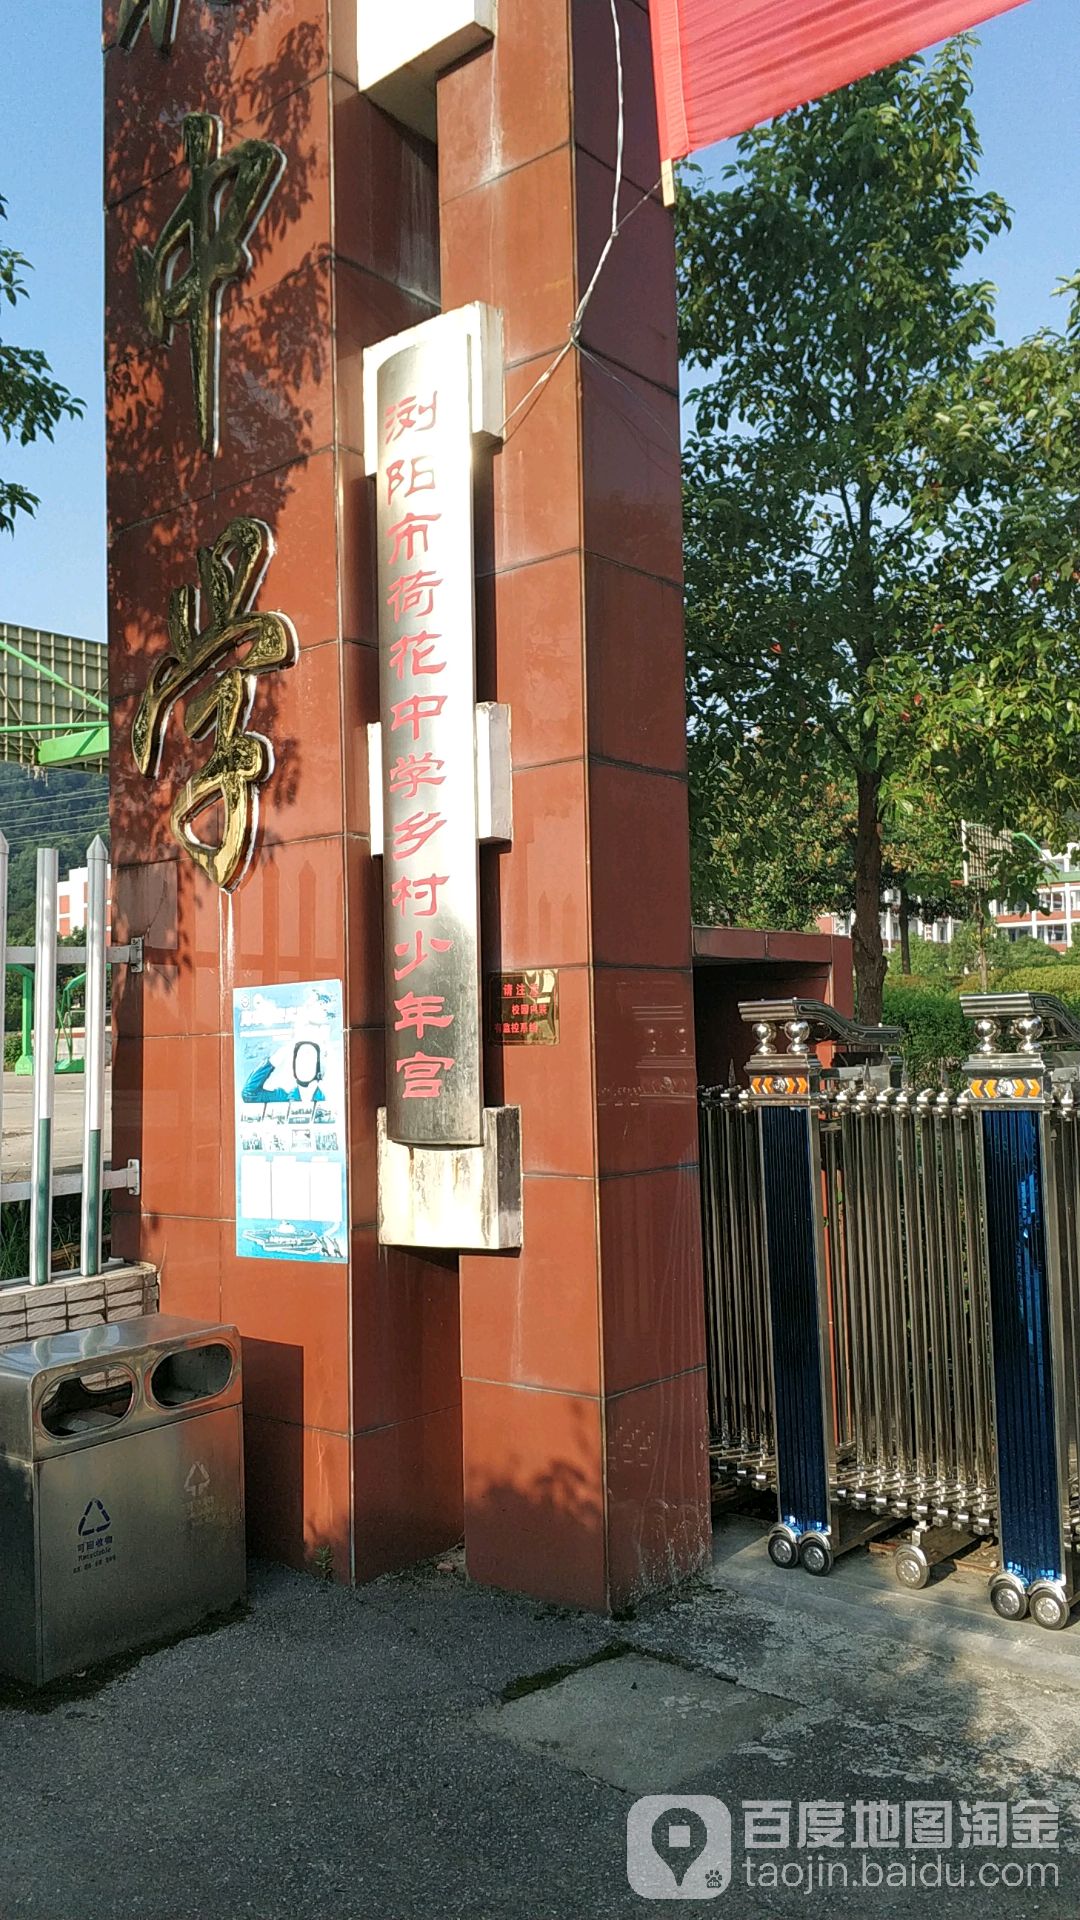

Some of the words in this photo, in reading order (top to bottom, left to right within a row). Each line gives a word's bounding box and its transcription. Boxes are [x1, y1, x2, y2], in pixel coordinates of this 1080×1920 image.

[384, 390, 456, 1099] 浏阳市荷花中学乡村少年宫
